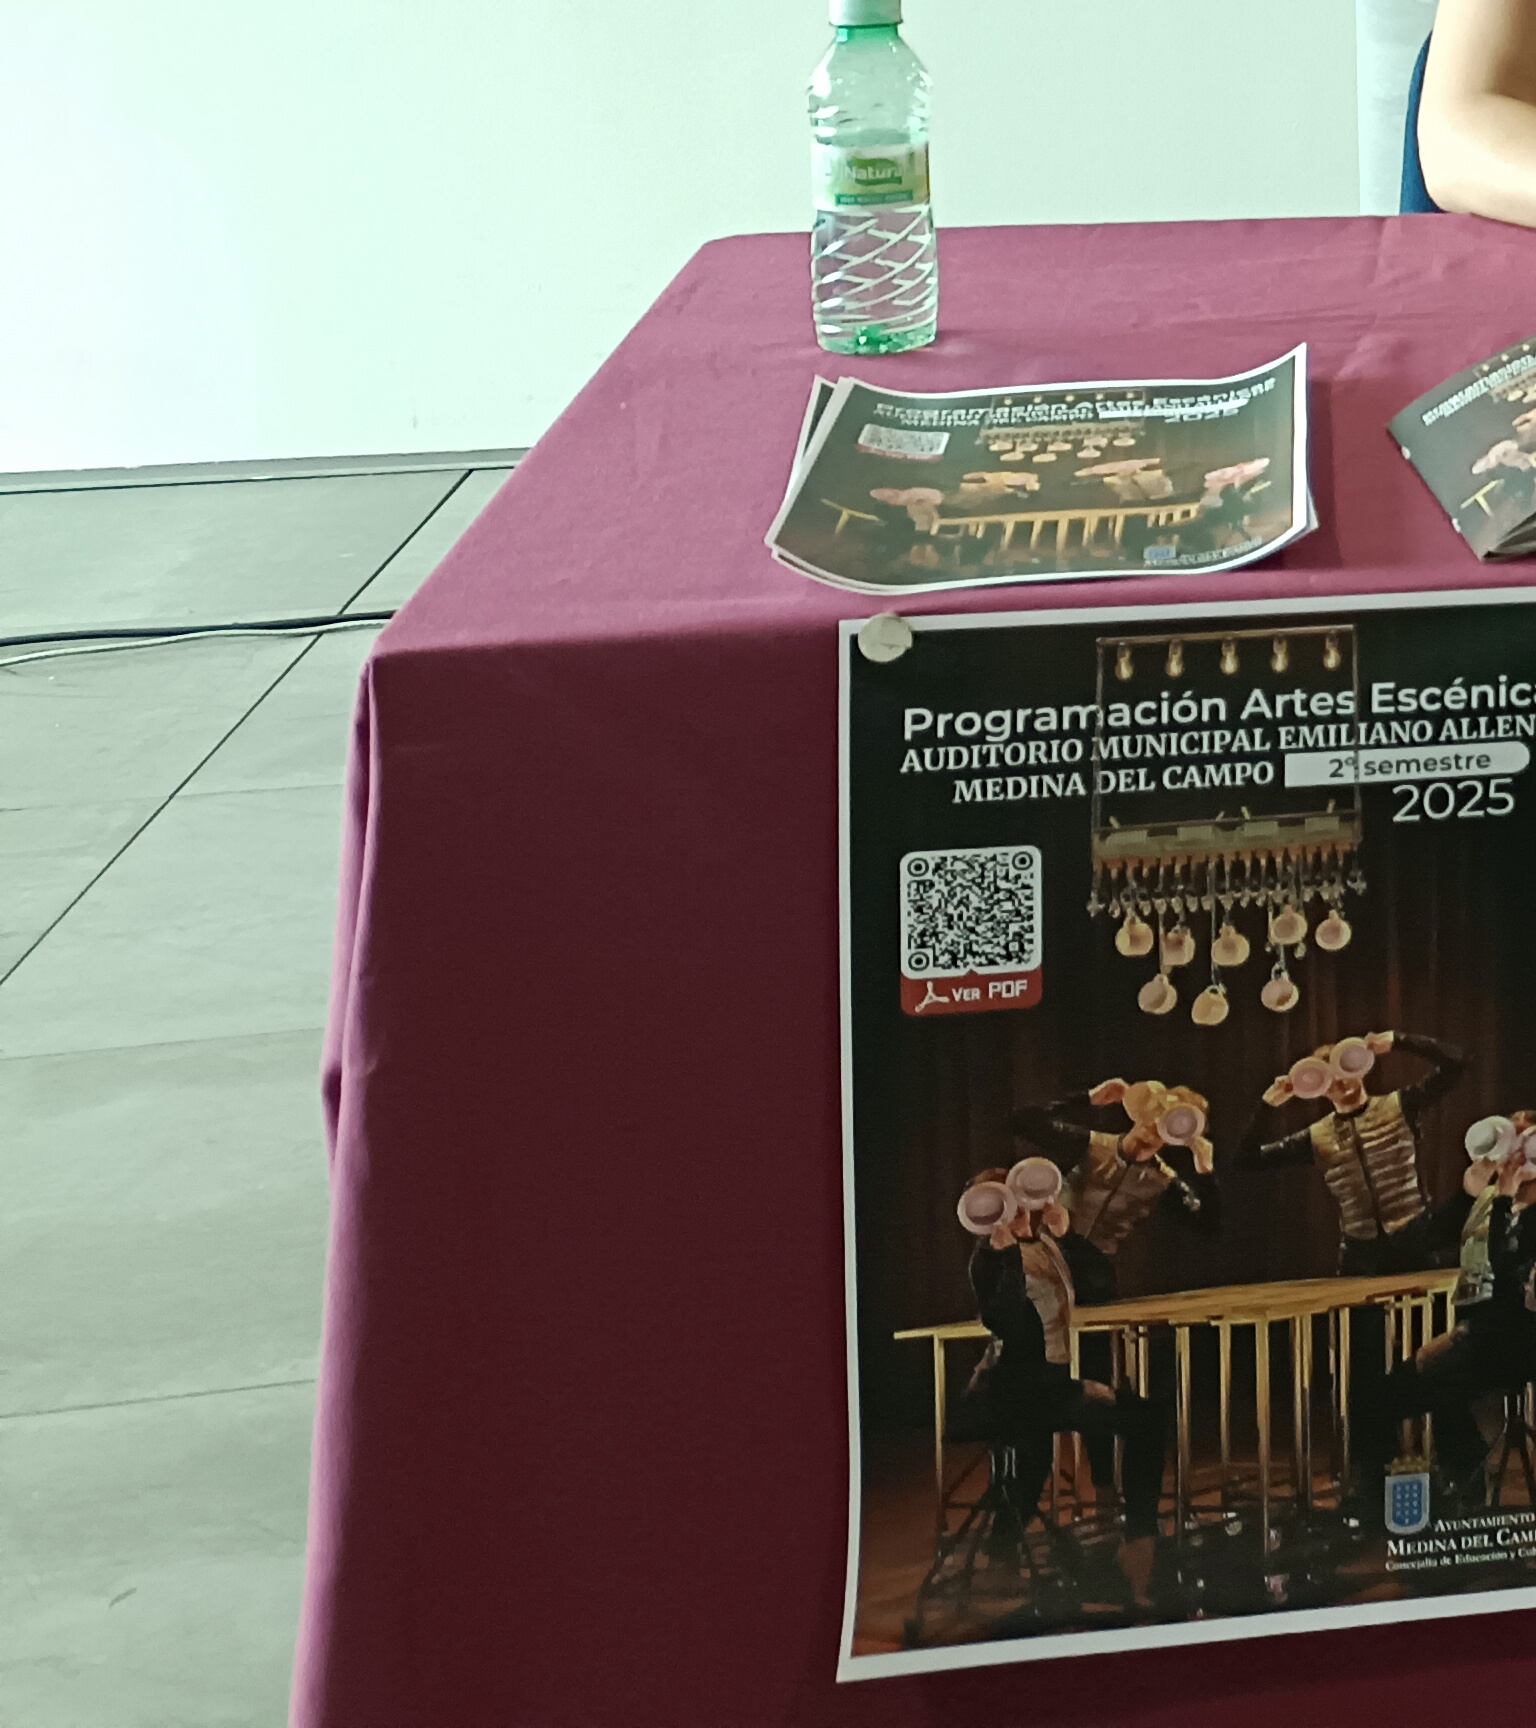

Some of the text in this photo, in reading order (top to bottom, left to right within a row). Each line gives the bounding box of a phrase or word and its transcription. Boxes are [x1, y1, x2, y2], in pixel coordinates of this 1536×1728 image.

[903, 689, 1226, 742] Programación
[1240, 688, 1356, 720] Artes
[900, 738, 1083, 773] AUDITORIO
[1091, 727, 1271, 761] MUNICIPAL
[1278, 719, 1433, 750] EMILIANO
[1363, 751, 1492, 776] semestre
[952, 761, 1274, 804] MEDINA DEL CAMPO
[1392, 777, 1515, 822] 2025
[988, 979, 1028, 999] PDF
[1387, 1538, 1457, 1557] MEDINA
[1461, 1534, 1493, 1549] DEL
